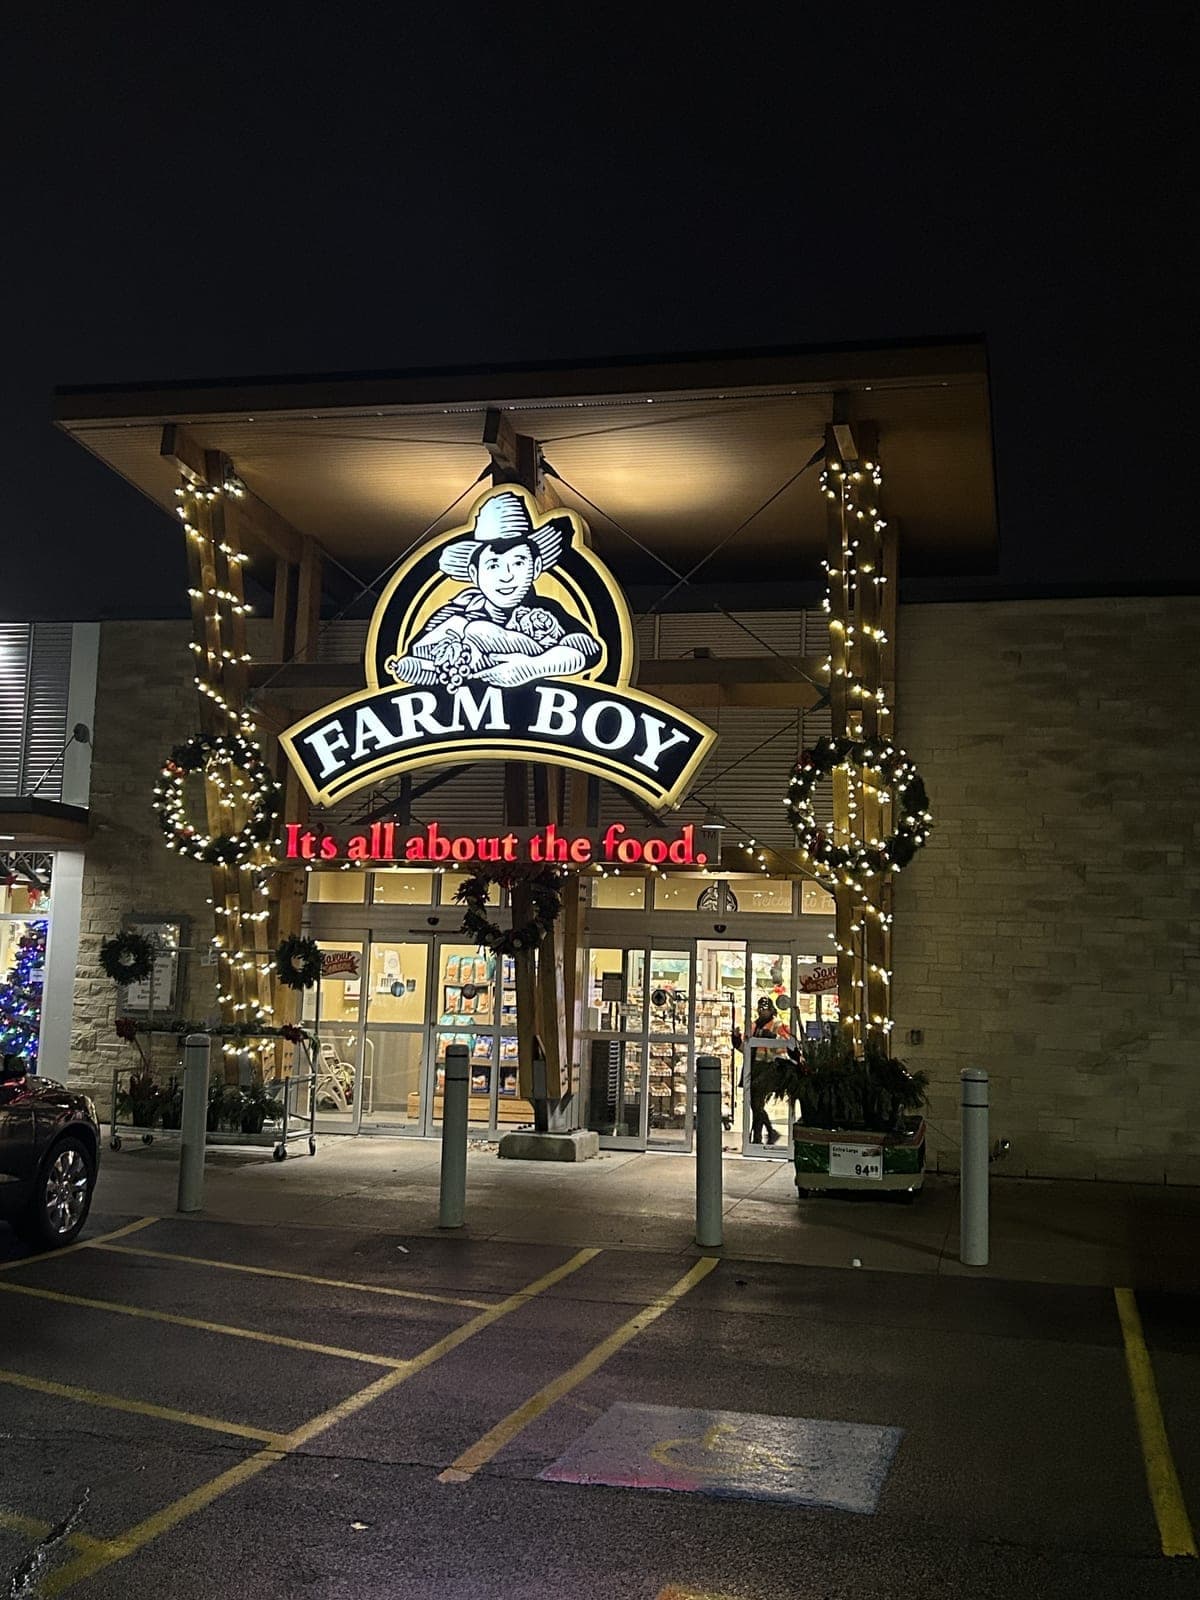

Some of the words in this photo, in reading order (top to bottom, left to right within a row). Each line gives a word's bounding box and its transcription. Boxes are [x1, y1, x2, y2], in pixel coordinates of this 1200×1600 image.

[303, 686, 511, 779] FARM
[529, 686, 691, 772] BOY
[285, 822, 337, 860] It's
[347, 821, 395, 861] all
[405, 822, 519, 862] about
[529, 823, 592, 864] the
[602, 822, 708, 865] food.
[752, 895, 792, 908] Welco
[812, 966, 838, 979] Savo
